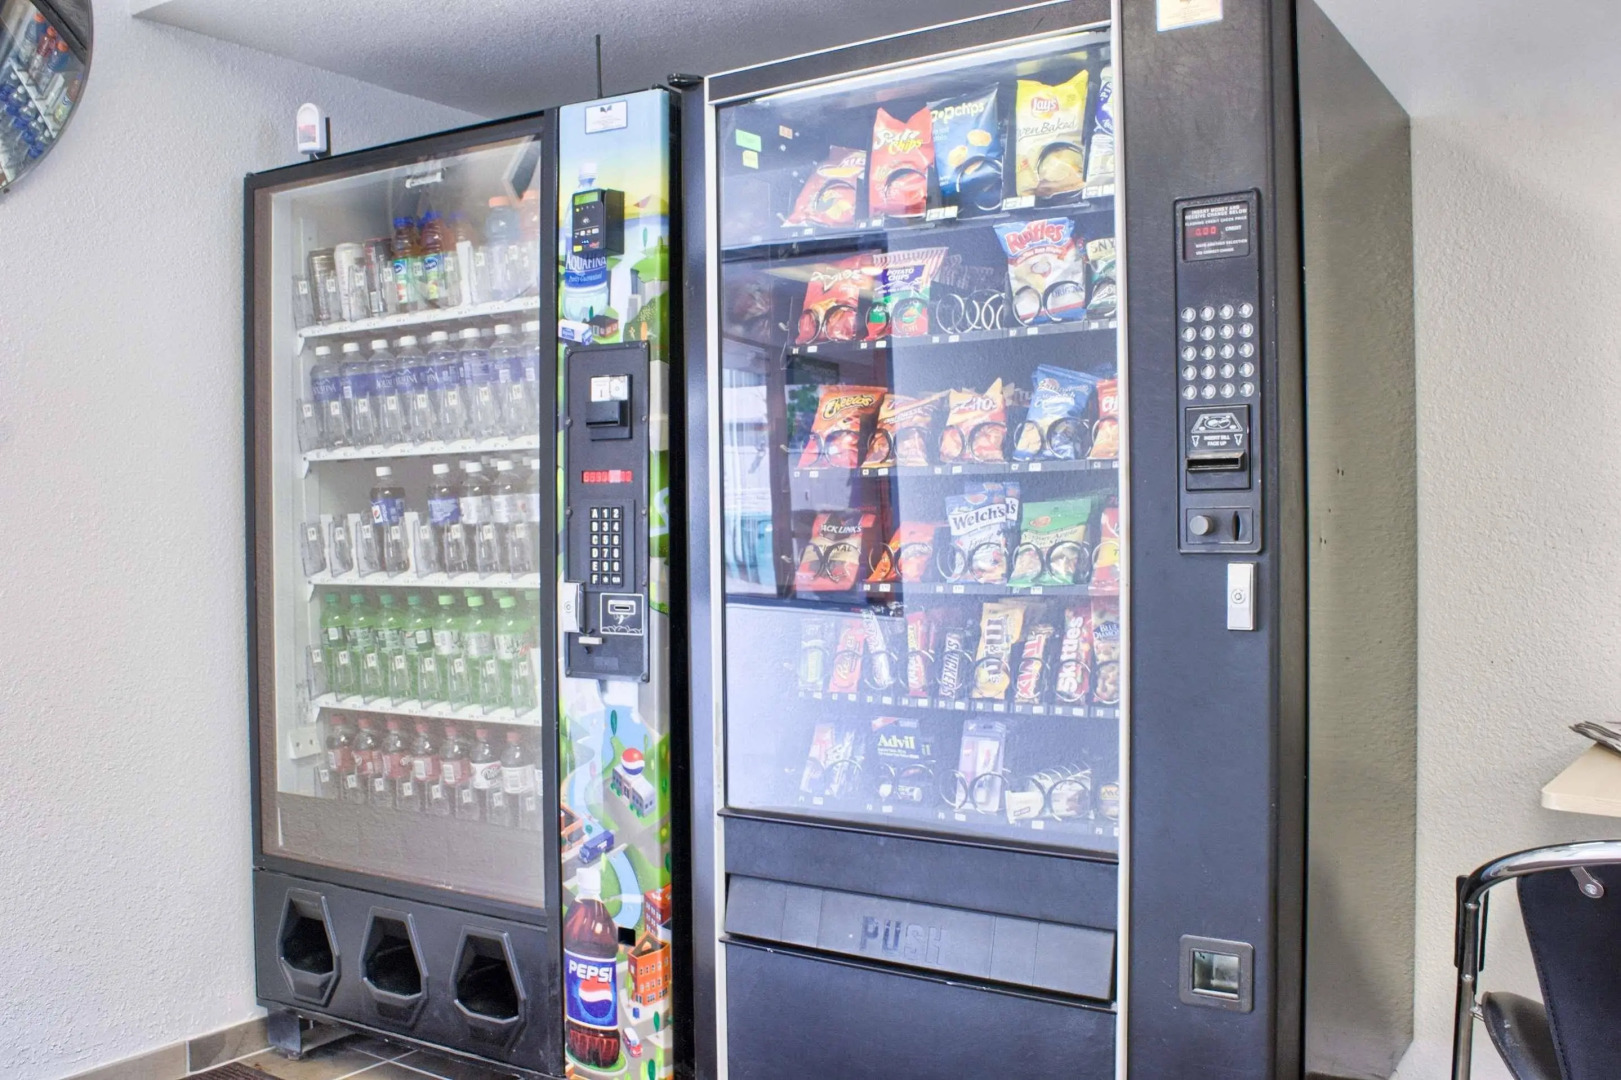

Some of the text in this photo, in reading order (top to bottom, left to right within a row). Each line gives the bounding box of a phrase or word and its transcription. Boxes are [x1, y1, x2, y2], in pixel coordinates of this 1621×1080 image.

[1006, 221, 1065, 255] Ruffles
[887, 267, 915, 276] POTATO
[888, 273, 910, 281] CHIPS
[823, 394, 874, 419] Cheetos
[592, 508, 599, 518] A
[602, 508, 609, 518] 1
[952, 506, 1005, 531] Welch's
[602, 522, 609, 532] 3
[592, 535, 599, 545] C
[602, 535, 609, 545] 5
[592, 548, 599, 558] D
[602, 548, 609, 558] 7
[592, 561, 599, 571] E
[602, 561, 609, 571] 9
[592, 574, 599, 584] F
[877, 734, 915, 750] Advil
[860, 916, 946, 966] PUSH
[568, 959, 613, 983] PEPSI
